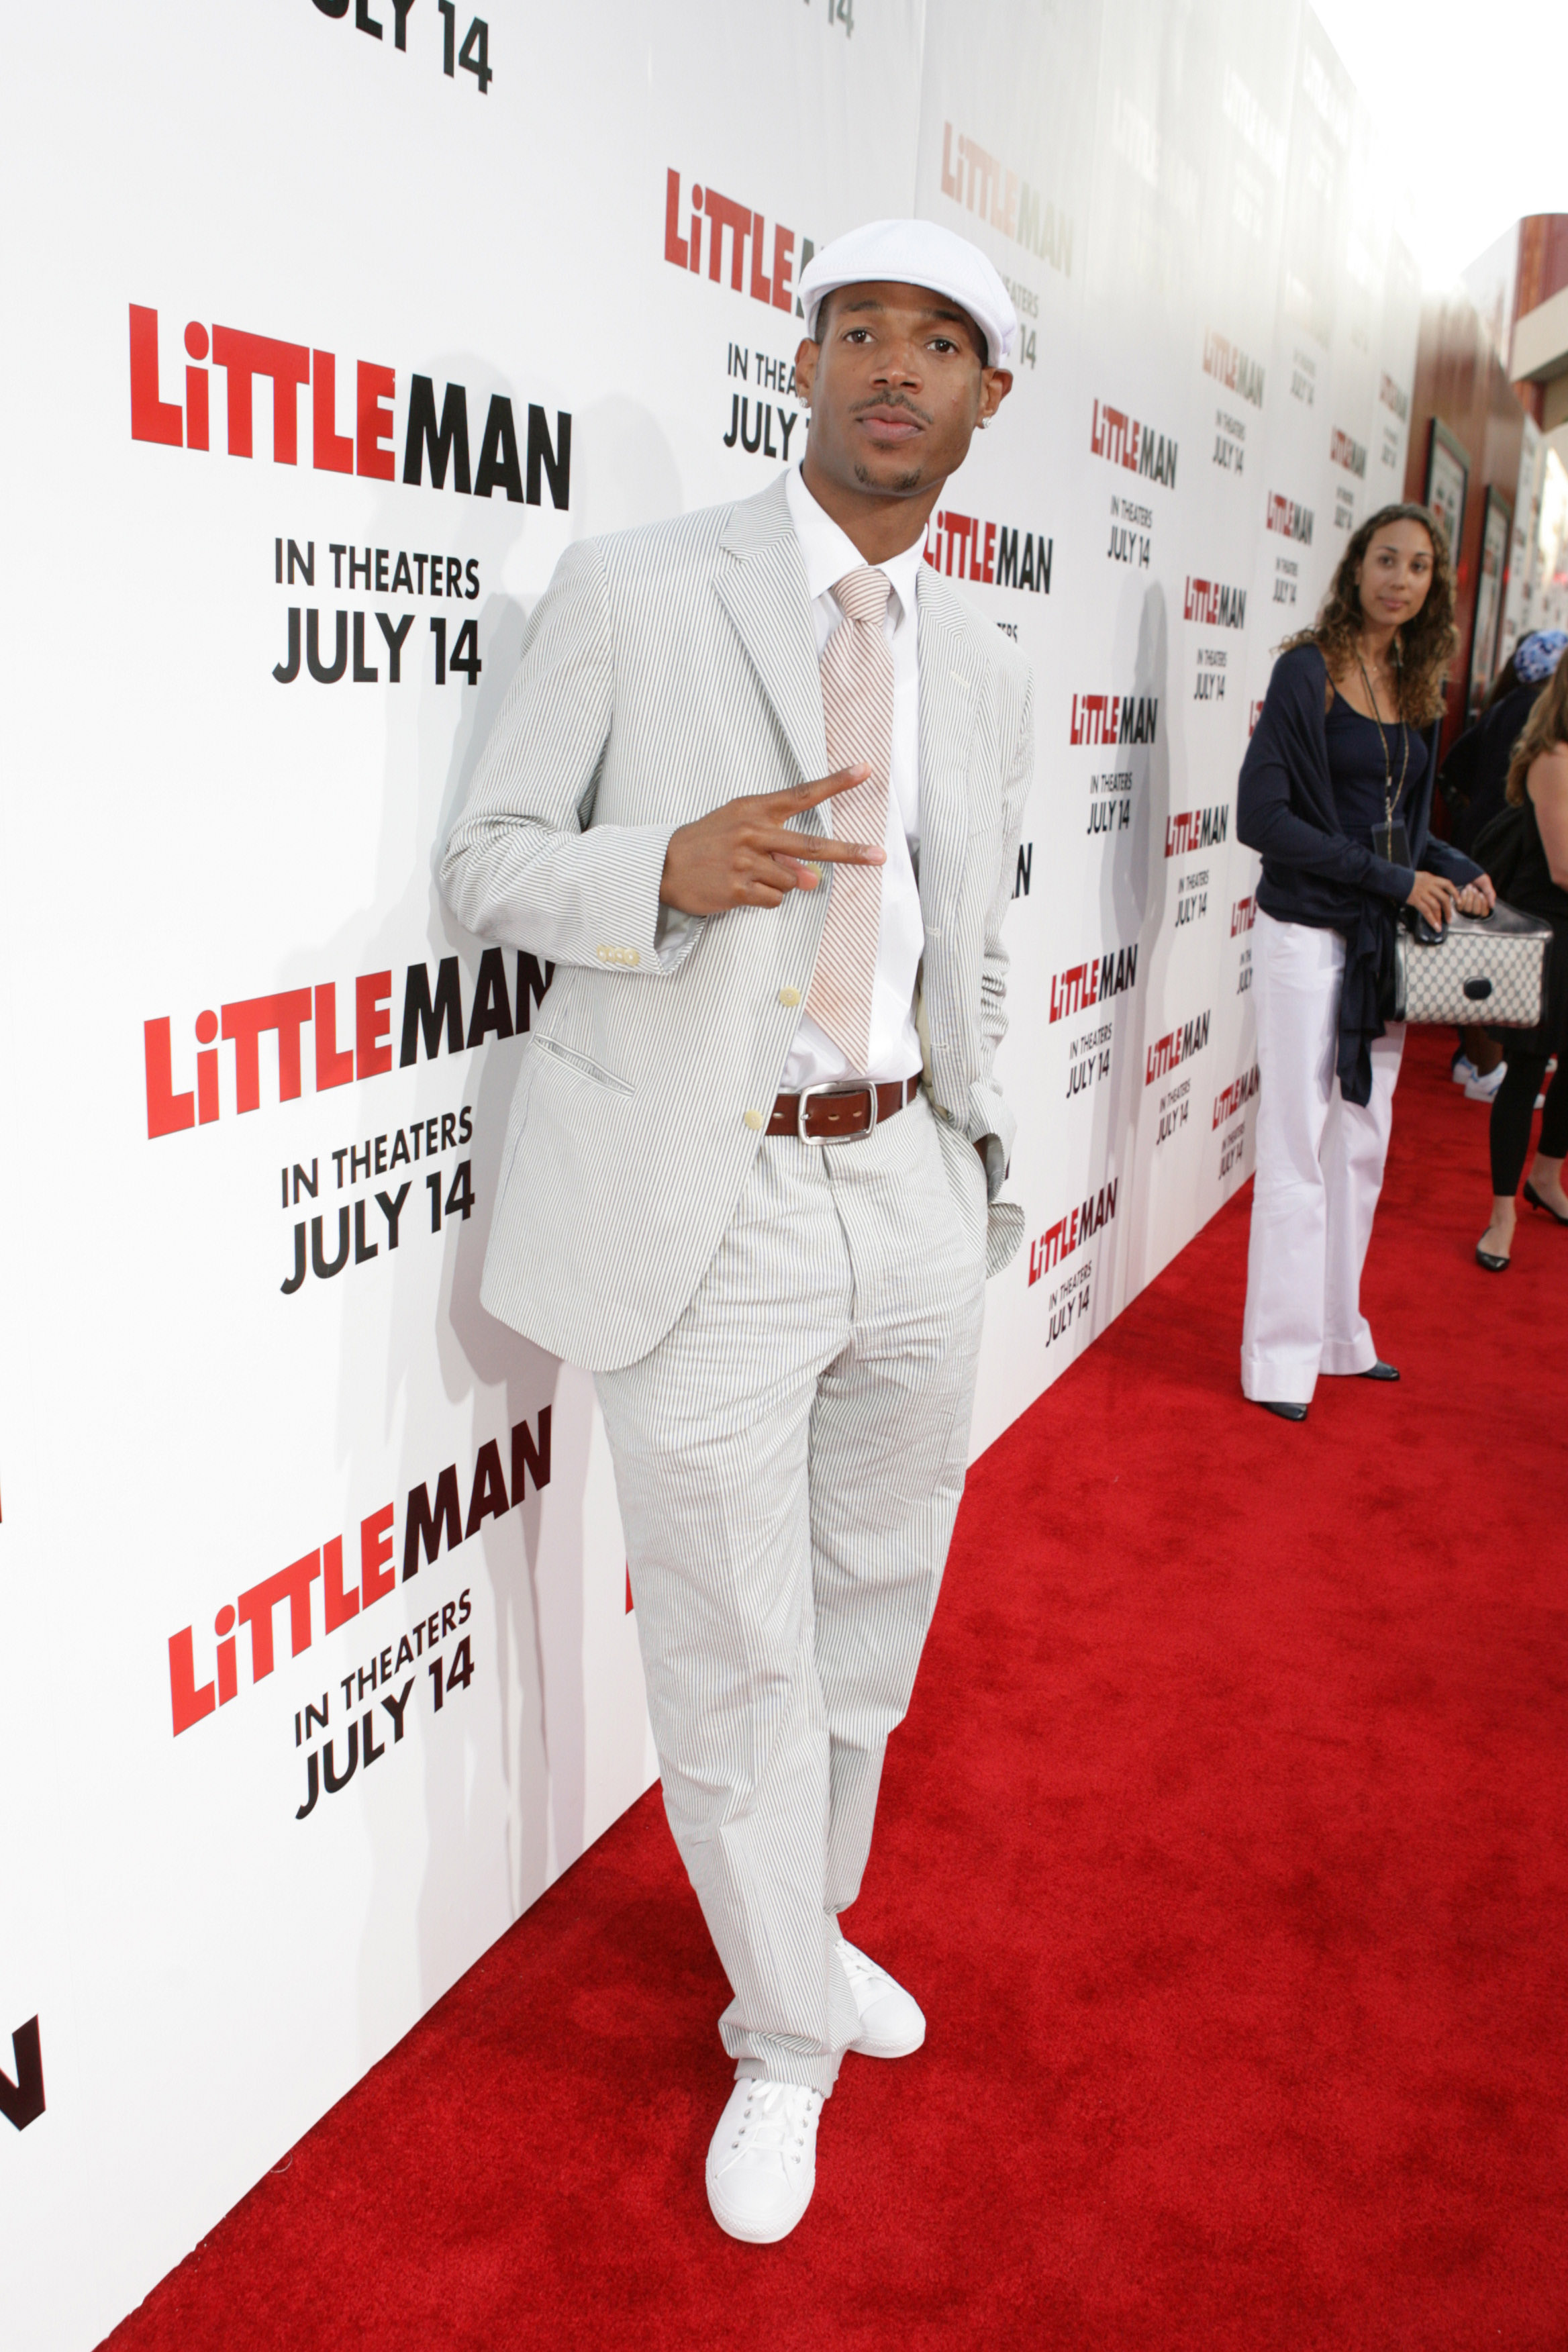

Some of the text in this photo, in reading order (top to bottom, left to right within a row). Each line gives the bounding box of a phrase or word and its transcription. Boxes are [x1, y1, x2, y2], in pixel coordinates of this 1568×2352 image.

[438, 0, 492, 95] 14
[728, 342, 748, 381] IN
[1020, 323, 1036, 370] 14
[723, 393, 797, 460] JULY
[1213, 436, 1244, 476] JULY 14
[1112, 495, 1152, 528] IN THEATERS
[275, 538, 480, 599] IN THEATERS
[1108, 526, 1151, 569] JULY 14
[1273, 579, 1289, 602] JULY
[272, 607, 482, 685] JULY 14
[1204, 649, 1227, 667] THEATERS
[1193, 673, 1225, 701] JULY 14
[1091, 773, 1132, 793] IN THEATERS
[1087, 799, 1131, 834] JULY 14
[1179, 868, 1209, 893] IN THEATERS
[1175, 892, 1207, 927] JULY 14
[1070, 1022, 1112, 1059] IN THEATERS
[1067, 1048, 1110, 1099] JULY 14
[1159, 1078, 1191, 1114] IN THEATERS
[1157, 1099, 1189, 1145] JULY 14
[282, 1106, 473, 1209] IN THEATERS
[1218, 1139, 1243, 1181] JULY 14
[280, 1160, 475, 1295] JULY 14
[1048, 1260, 1091, 1312] IN THEATERS
[1046, 1283, 1091, 1347] JULY 14
[295, 1587, 472, 1748] IN THEATERS
[295, 1636, 475, 1820] JULY 14
